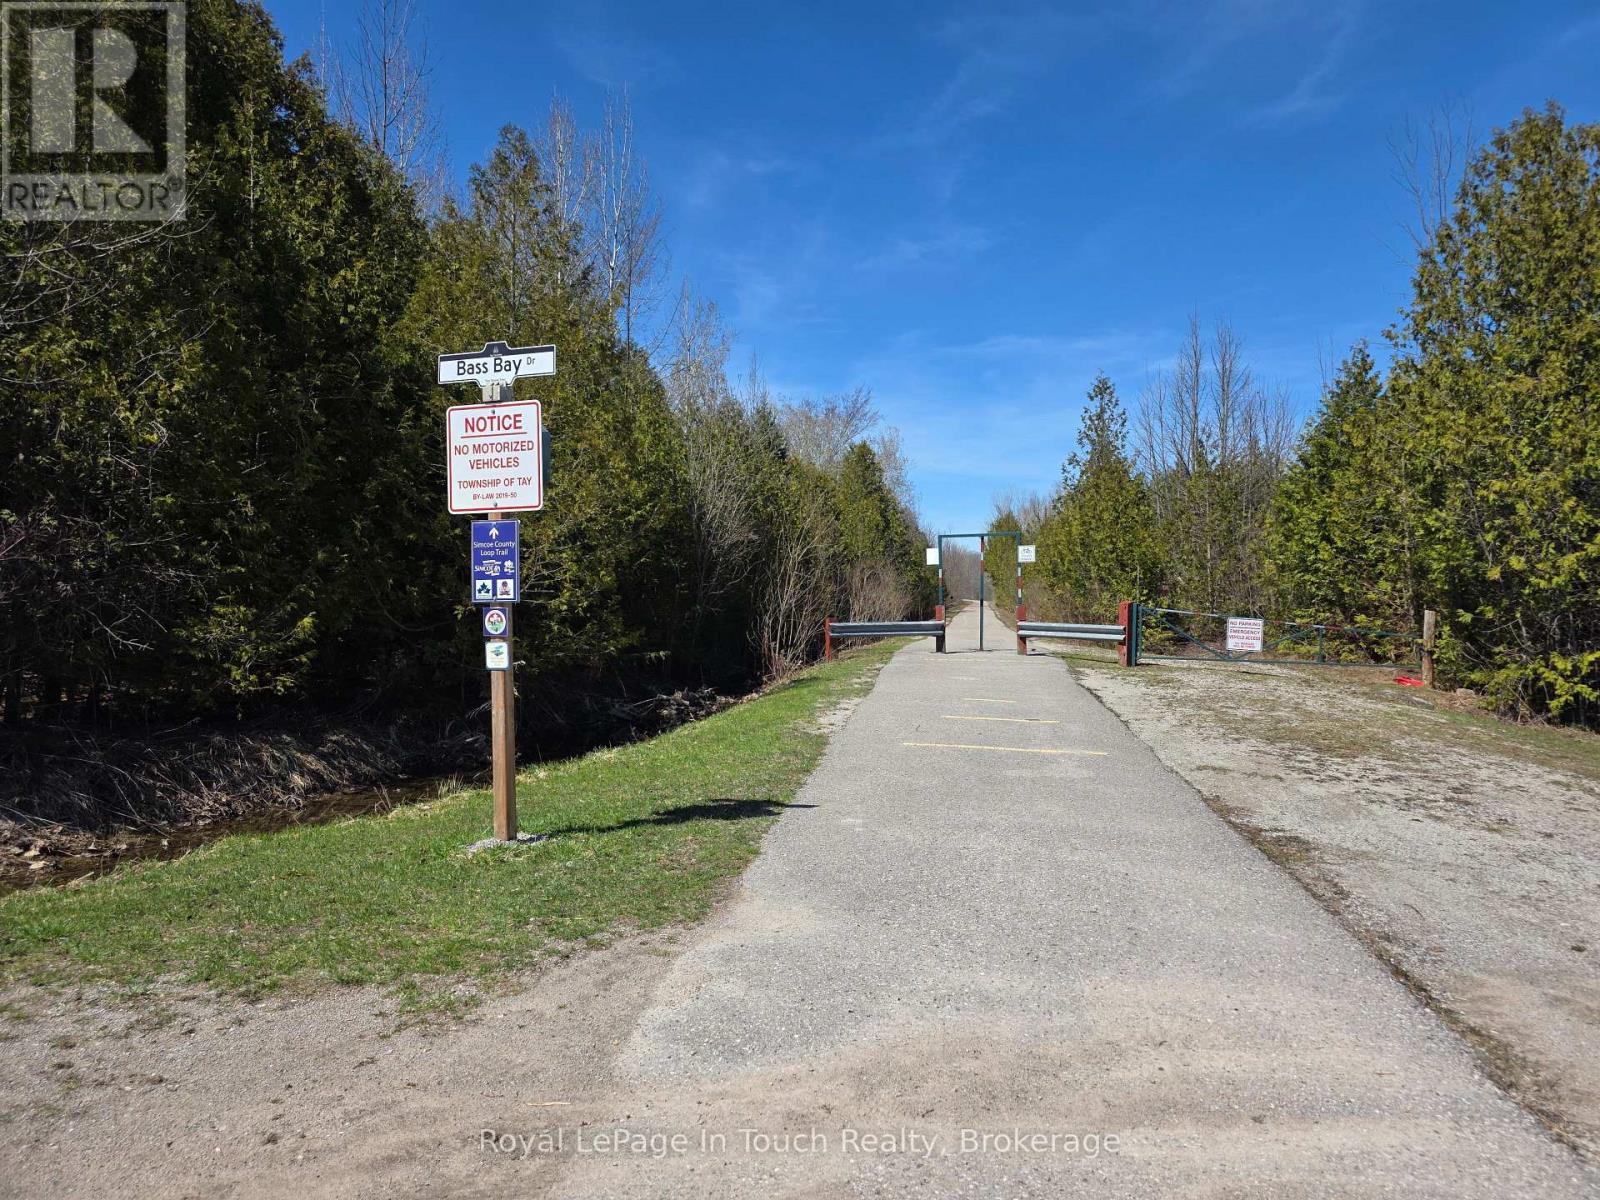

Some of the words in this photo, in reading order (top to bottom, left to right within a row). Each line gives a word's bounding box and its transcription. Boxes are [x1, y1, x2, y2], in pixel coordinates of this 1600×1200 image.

[457, 361, 488, 375] Bass
[494, 357, 522, 375] Bay
[526, 356, 536, 365] Dr
[465, 414, 523, 433] NOTICE
[454, 445, 469, 455] NO
[473, 440, 534, 454] MOTORIZED
[469, 457, 520, 469] VEHICLES
[458, 478, 501, 489] TOWNSHIP
[503, 478, 515, 486] OF
[518, 477, 532, 486] TAY
[473, 541, 494, 549] Simcoe
[494, 540, 515, 549] County
[480, 549, 495, 557] Loop
[495, 548, 509, 556] Trail
